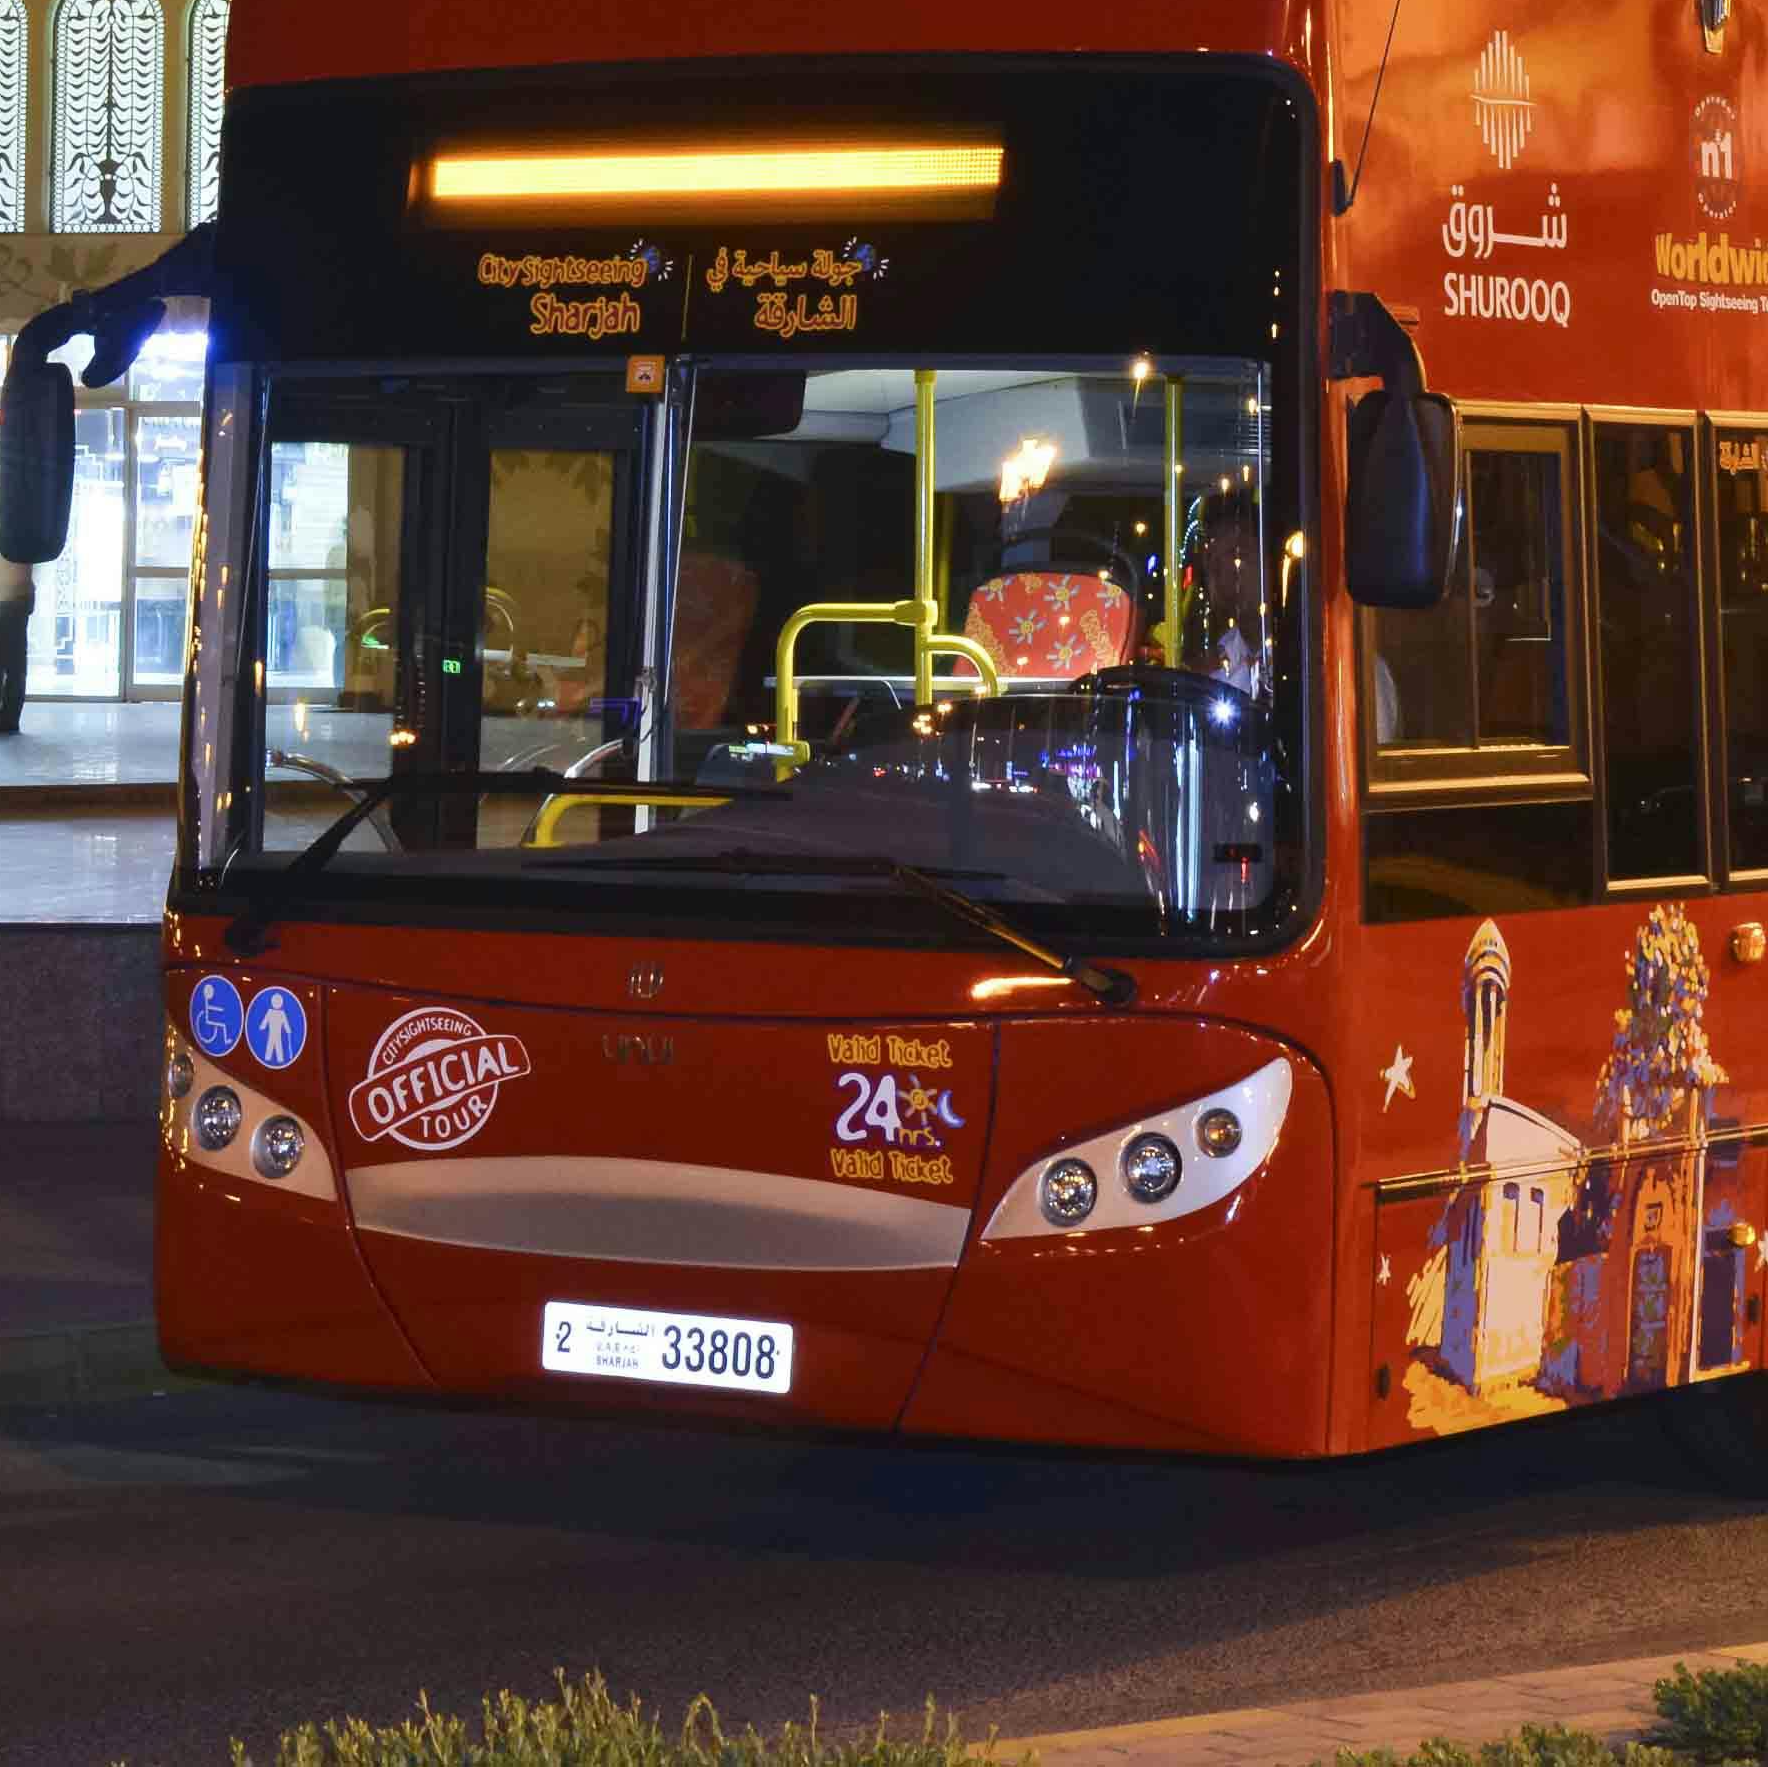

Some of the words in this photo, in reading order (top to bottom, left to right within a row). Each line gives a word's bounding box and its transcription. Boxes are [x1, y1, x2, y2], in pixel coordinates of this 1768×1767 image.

[530, 290, 641, 340] Sharjah
[754, 291, 857, 338] الشارقة
[1443, 271, 1571, 328] SHUROOQ
[1699, 291, 1758, 313] Sightseeing
[382, 1017, 472, 1065] CITYSIGHTSEEING
[827, 1033, 881, 1064] Valid
[886, 1035, 954, 1069] Ticket
[367, 1041, 520, 1124] OFFICIAL
[419, 1095, 488, 1138] TOUR
[836, 1072, 903, 1142] 24
[830, 1148, 883, 1178] Valid
[888, 1150, 954, 1184] Ticket
[558, 1321, 573, 1353] 2
[661, 1324, 776, 1379] 33808
[596, 1354, 640, 1369] SHARJAH
